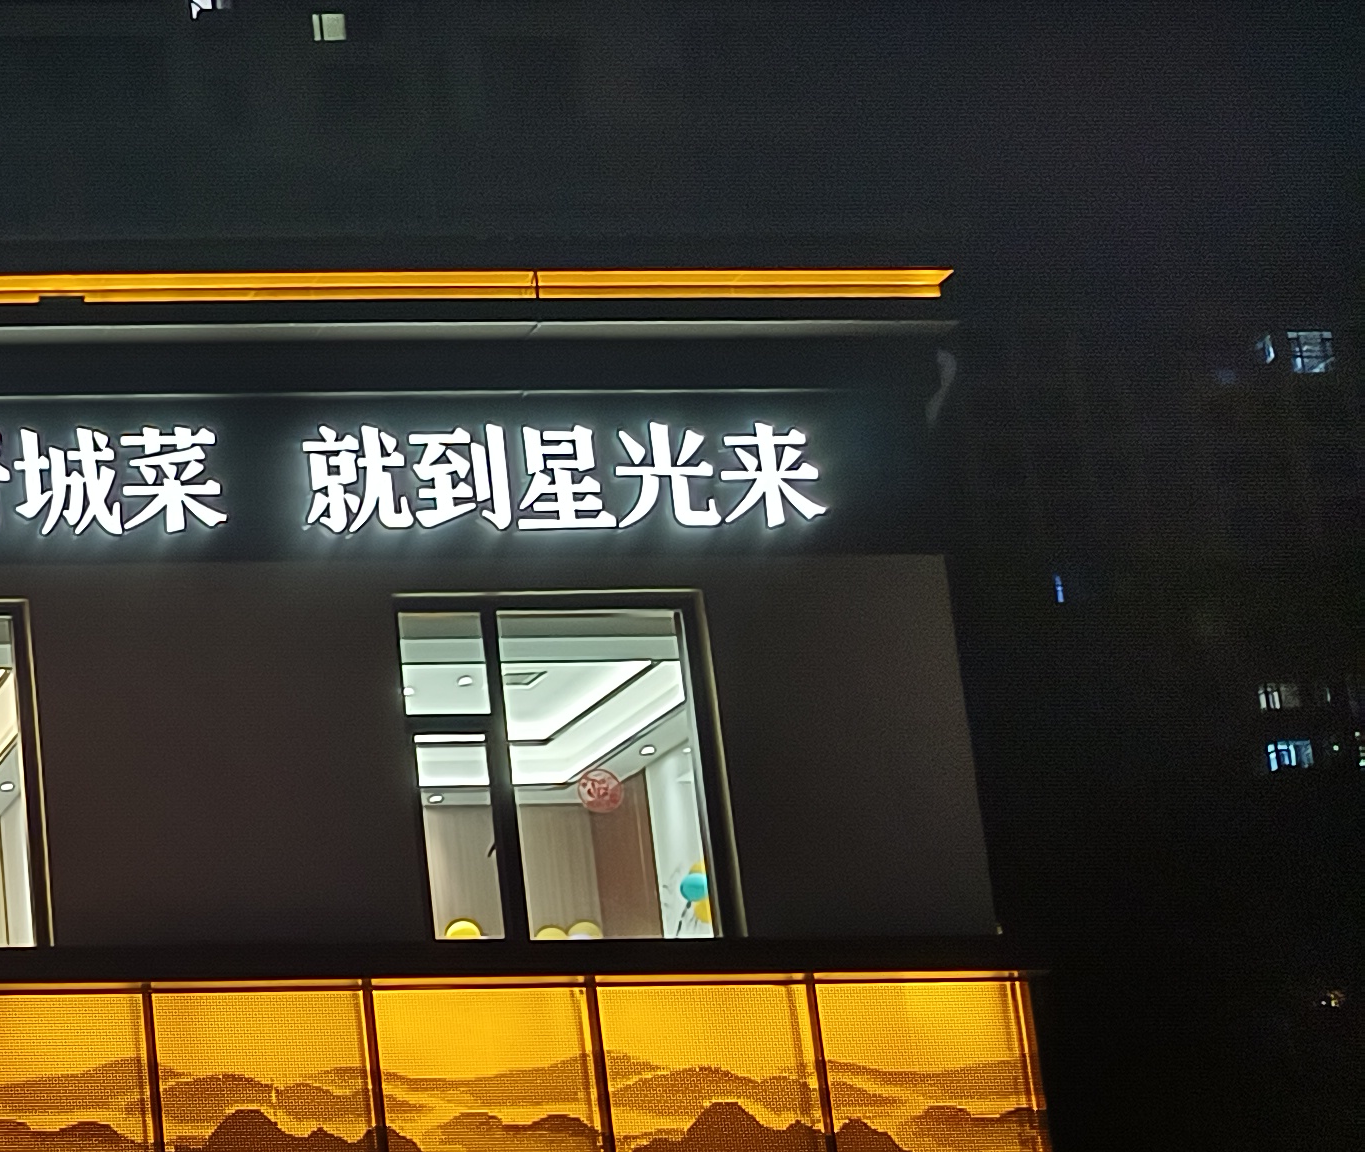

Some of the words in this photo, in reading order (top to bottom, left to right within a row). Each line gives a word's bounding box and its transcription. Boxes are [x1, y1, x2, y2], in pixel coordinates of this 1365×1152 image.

[300, 422, 827, 533] 就到星光来
